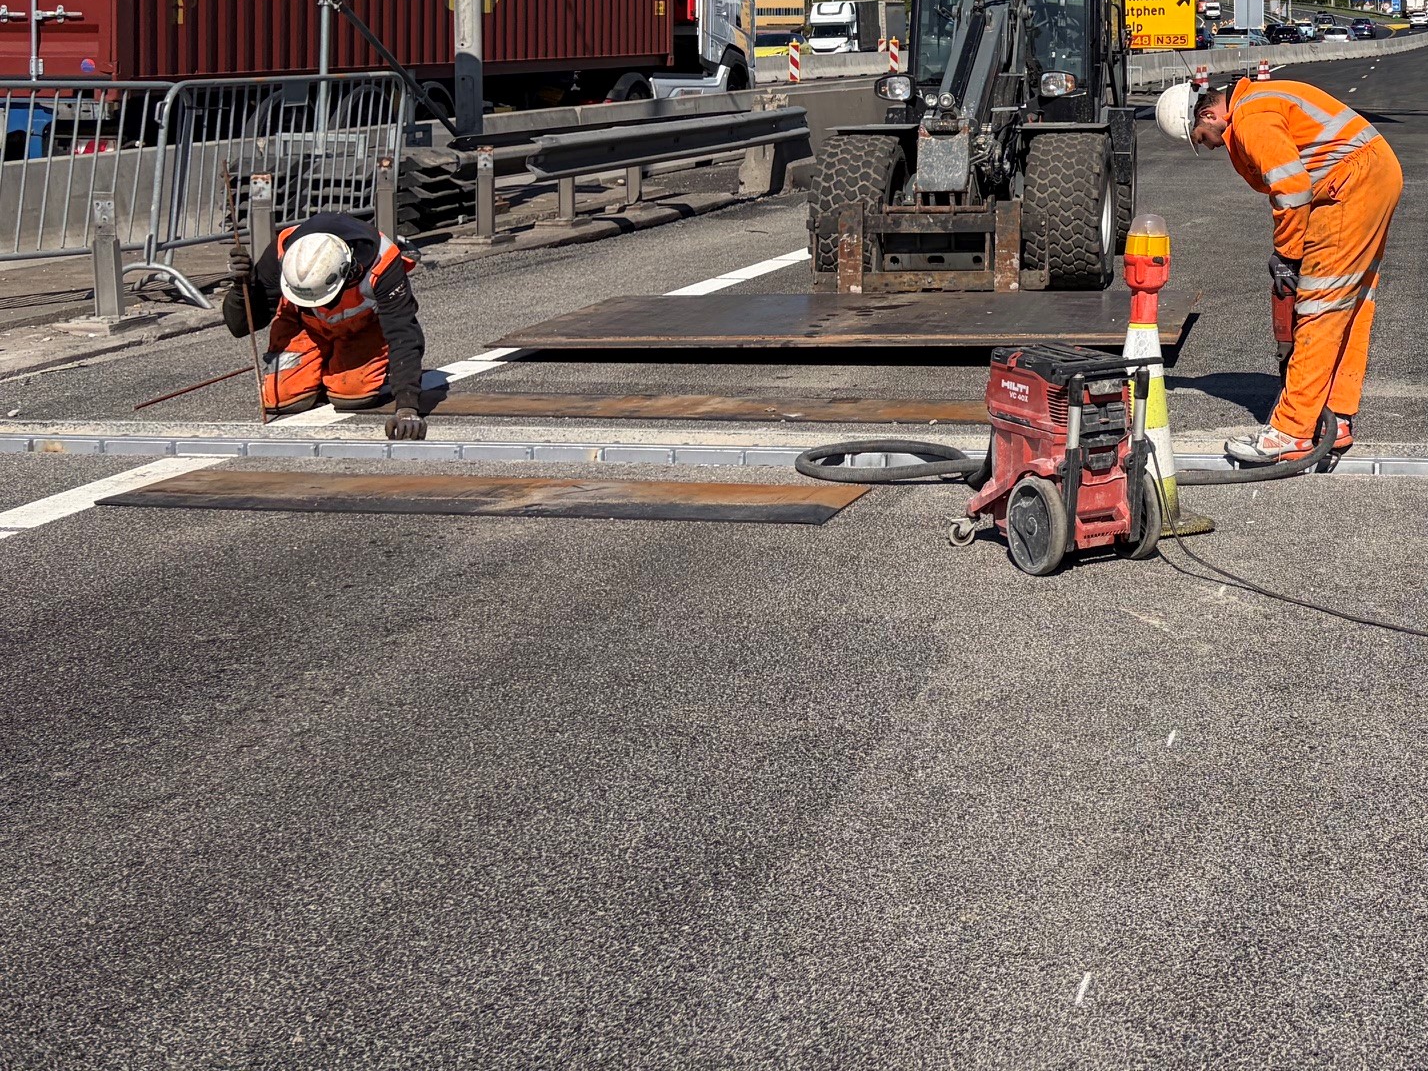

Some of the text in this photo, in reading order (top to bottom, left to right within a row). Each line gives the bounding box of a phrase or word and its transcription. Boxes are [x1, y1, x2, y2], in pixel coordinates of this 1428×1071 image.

[1125, 6, 1165, 18] utphen
[1126, 21, 1143, 33] elp
[1001, 379, 1030, 395] HILTI
